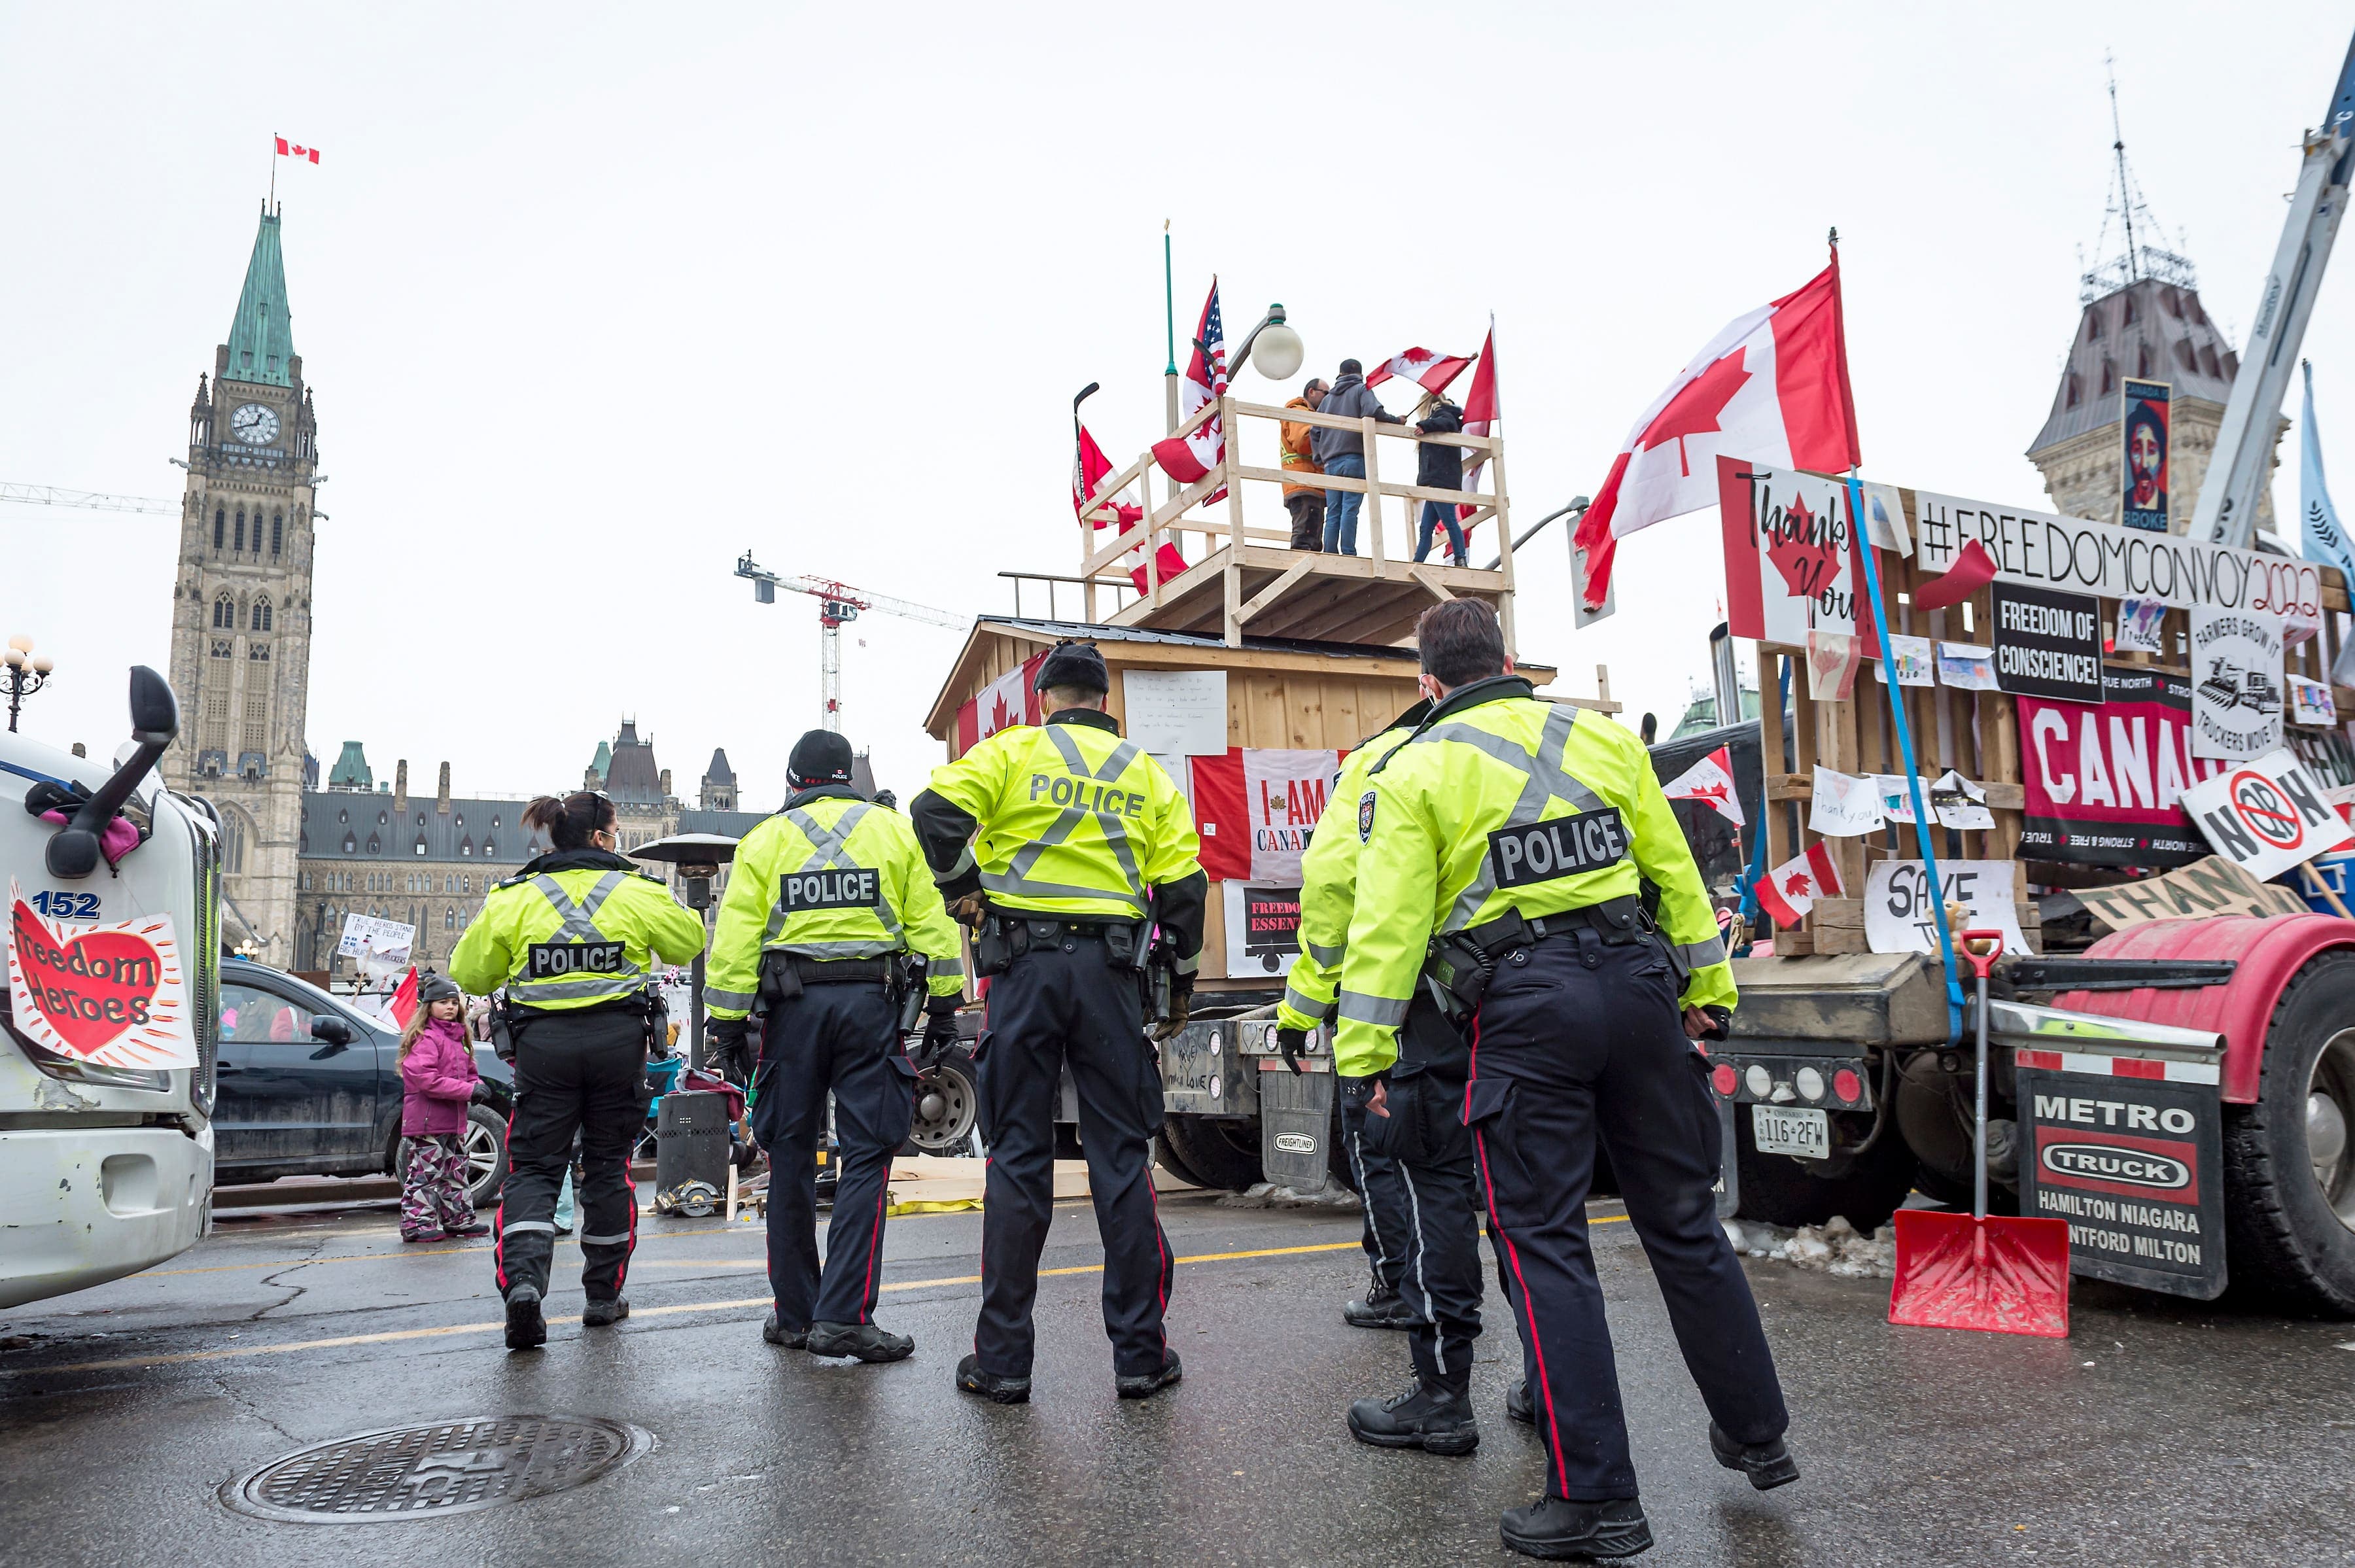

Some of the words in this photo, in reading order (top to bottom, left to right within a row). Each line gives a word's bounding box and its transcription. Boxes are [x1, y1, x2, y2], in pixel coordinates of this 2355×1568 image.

[1736, 472, 1851, 557] Thank
[2123, 510, 2167, 529] BROKE
[2000, 600, 2073, 638] FREEDOM
[2076, 612, 2095, 642] OF
[2195, 618, 2238, 650] FARMERS
[2242, 619, 2270, 648] GROW
[2268, 640, 2280, 658] IT
[1998, 645, 2098, 686] CONSCIENCE!
[2102, 676, 2120, 688] RUE
[2121, 676, 2152, 689] NORTH
[2168, 684, 2192, 698] STRO
[2197, 710, 2244, 752] TRUCKERS
[2247, 726, 2271, 751] MOVE
[2268, 718, 2280, 736] IT
[2032, 708, 2227, 811] CANA
[1030, 774, 1145, 818] POLICE
[1261, 780, 1271, 826] I
[1287, 778, 1327, 826] AM
[1361, 793, 1375, 807] POLICE
[1815, 791, 1846, 820] Thank
[1498, 814, 1624, 880] POLICE
[2025, 831, 2053, 845] TRUE
[2070, 835, 2090, 846] FREE
[2098, 835, 2135, 848] STRONG
[2153, 839, 2186, 852] NORTH
[788, 871, 874, 906] POLICE
[2074, 858, 2256, 920] THAN
[33, 890, 101, 919] 152
[1251, 902, 1301, 915] FREEDO
[352, 916, 369, 925] TRUE
[395, 924, 414, 933] STAND
[354, 923, 364, 932] BY
[368, 926, 380, 935] THE
[383, 929, 406, 940] PEOPLE
[1251, 917, 1301, 932] ESSENT
[12, 910, 157, 988] Freedom
[340, 945, 350, 954] BIG
[381, 954, 406, 964] TRUCKERS
[534, 946, 621, 974] POLICE
[24, 969, 151, 1025] Heroes
[1186, 1073, 1207, 1090] LOVE
[2034, 1094, 2195, 1134] METRO
[1278, 1138, 1312, 1149] FREIGHTLINER
[2057, 1151, 2171, 1181] TRUCK
[2038, 1191, 2116, 1222] HAMILTON
[2121, 1204, 2200, 1235] NIAGARA
[2068, 1227, 2130, 1254] NTFORD
[2135, 1235, 2201, 1266] MILTON
